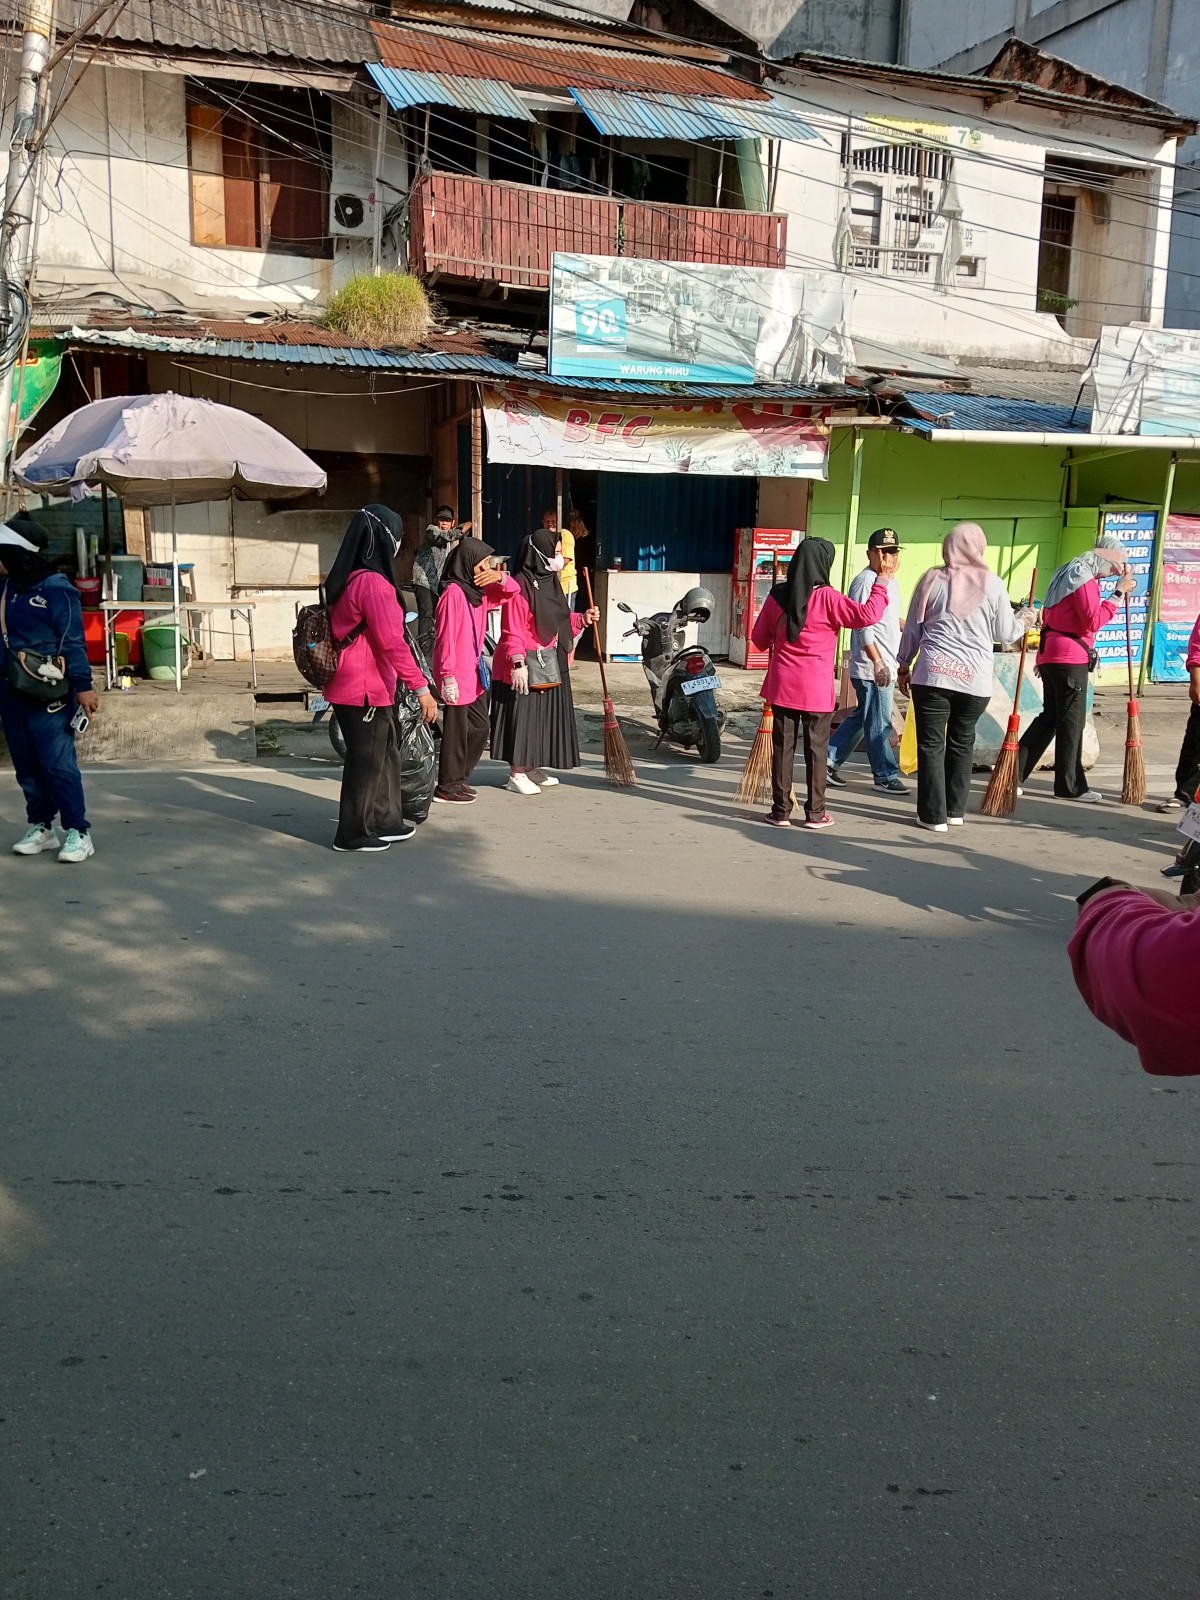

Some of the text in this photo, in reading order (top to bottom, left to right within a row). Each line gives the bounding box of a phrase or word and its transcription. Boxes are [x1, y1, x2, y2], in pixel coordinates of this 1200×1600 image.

[958, 129, 968, 144] 7
[620, 364, 690, 377] WARUNG MIMU
[563, 408, 654, 448] BFC
[1105, 513, 1138, 524] PULSA
